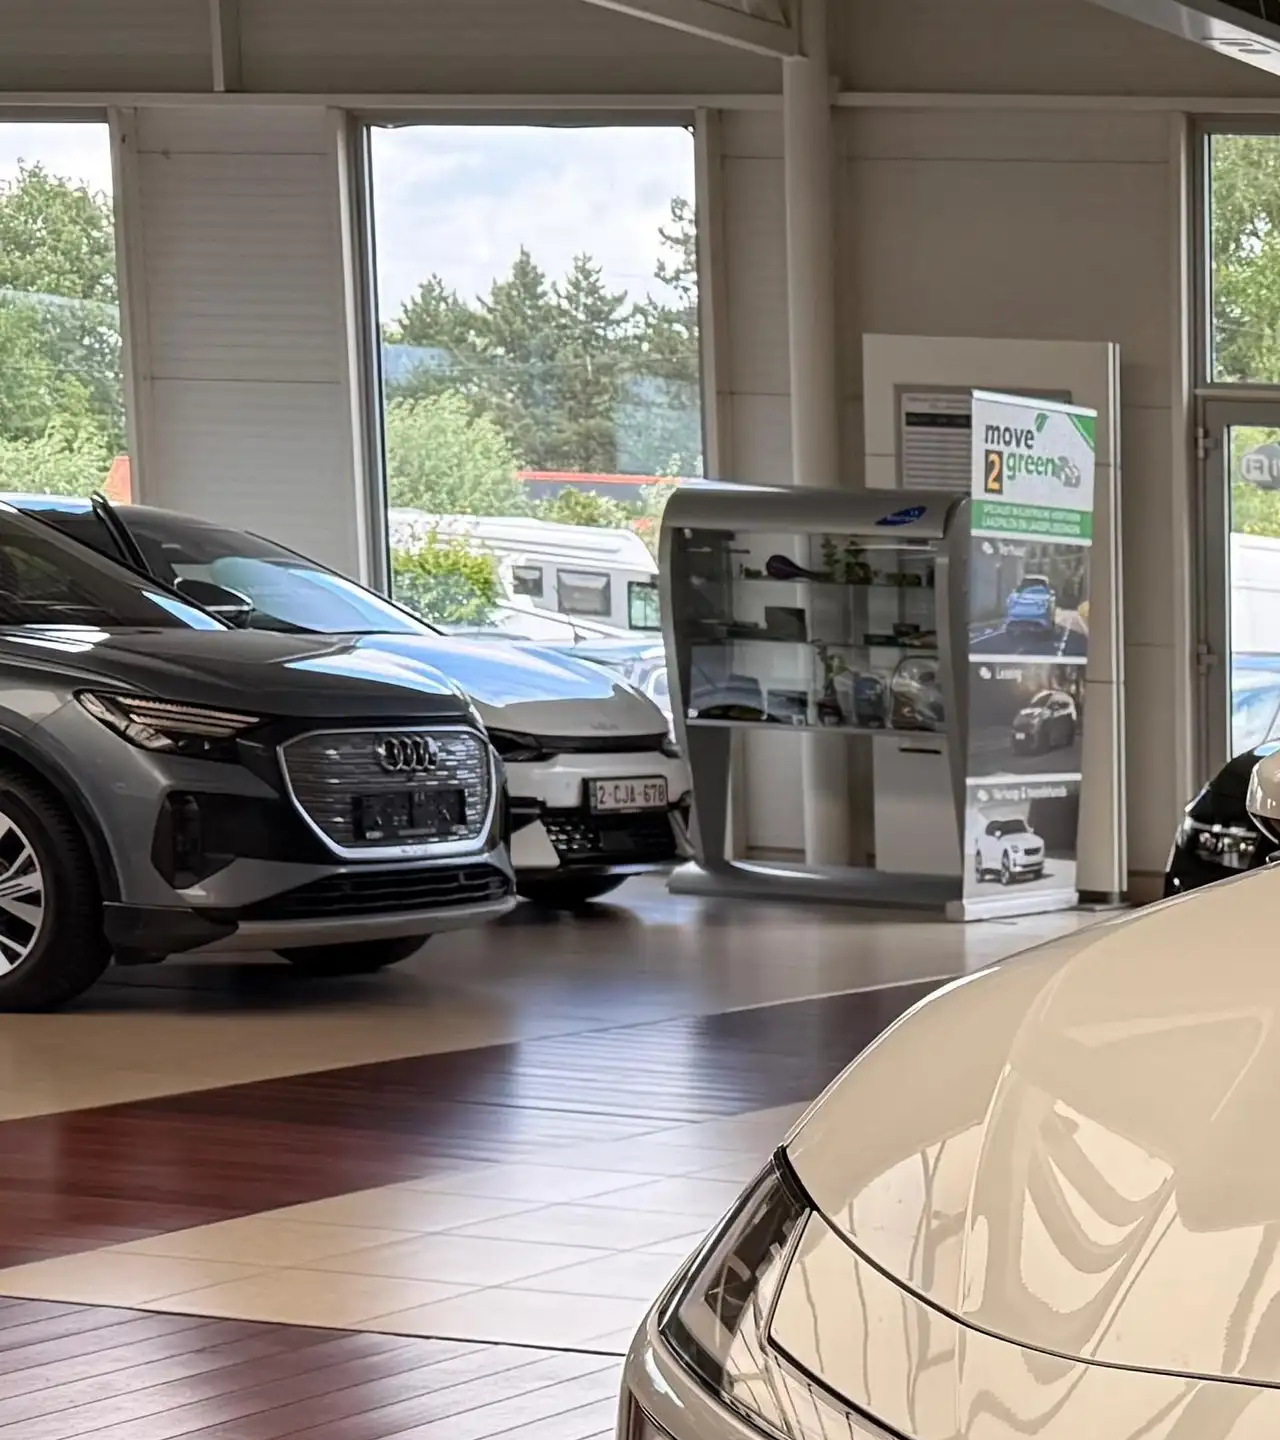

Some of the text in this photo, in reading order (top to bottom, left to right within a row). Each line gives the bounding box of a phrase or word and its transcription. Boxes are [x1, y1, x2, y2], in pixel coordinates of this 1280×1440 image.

[985, 424, 1035, 450] move
[986, 452, 1001, 491] 2
[1006, 452, 1056, 482] green
